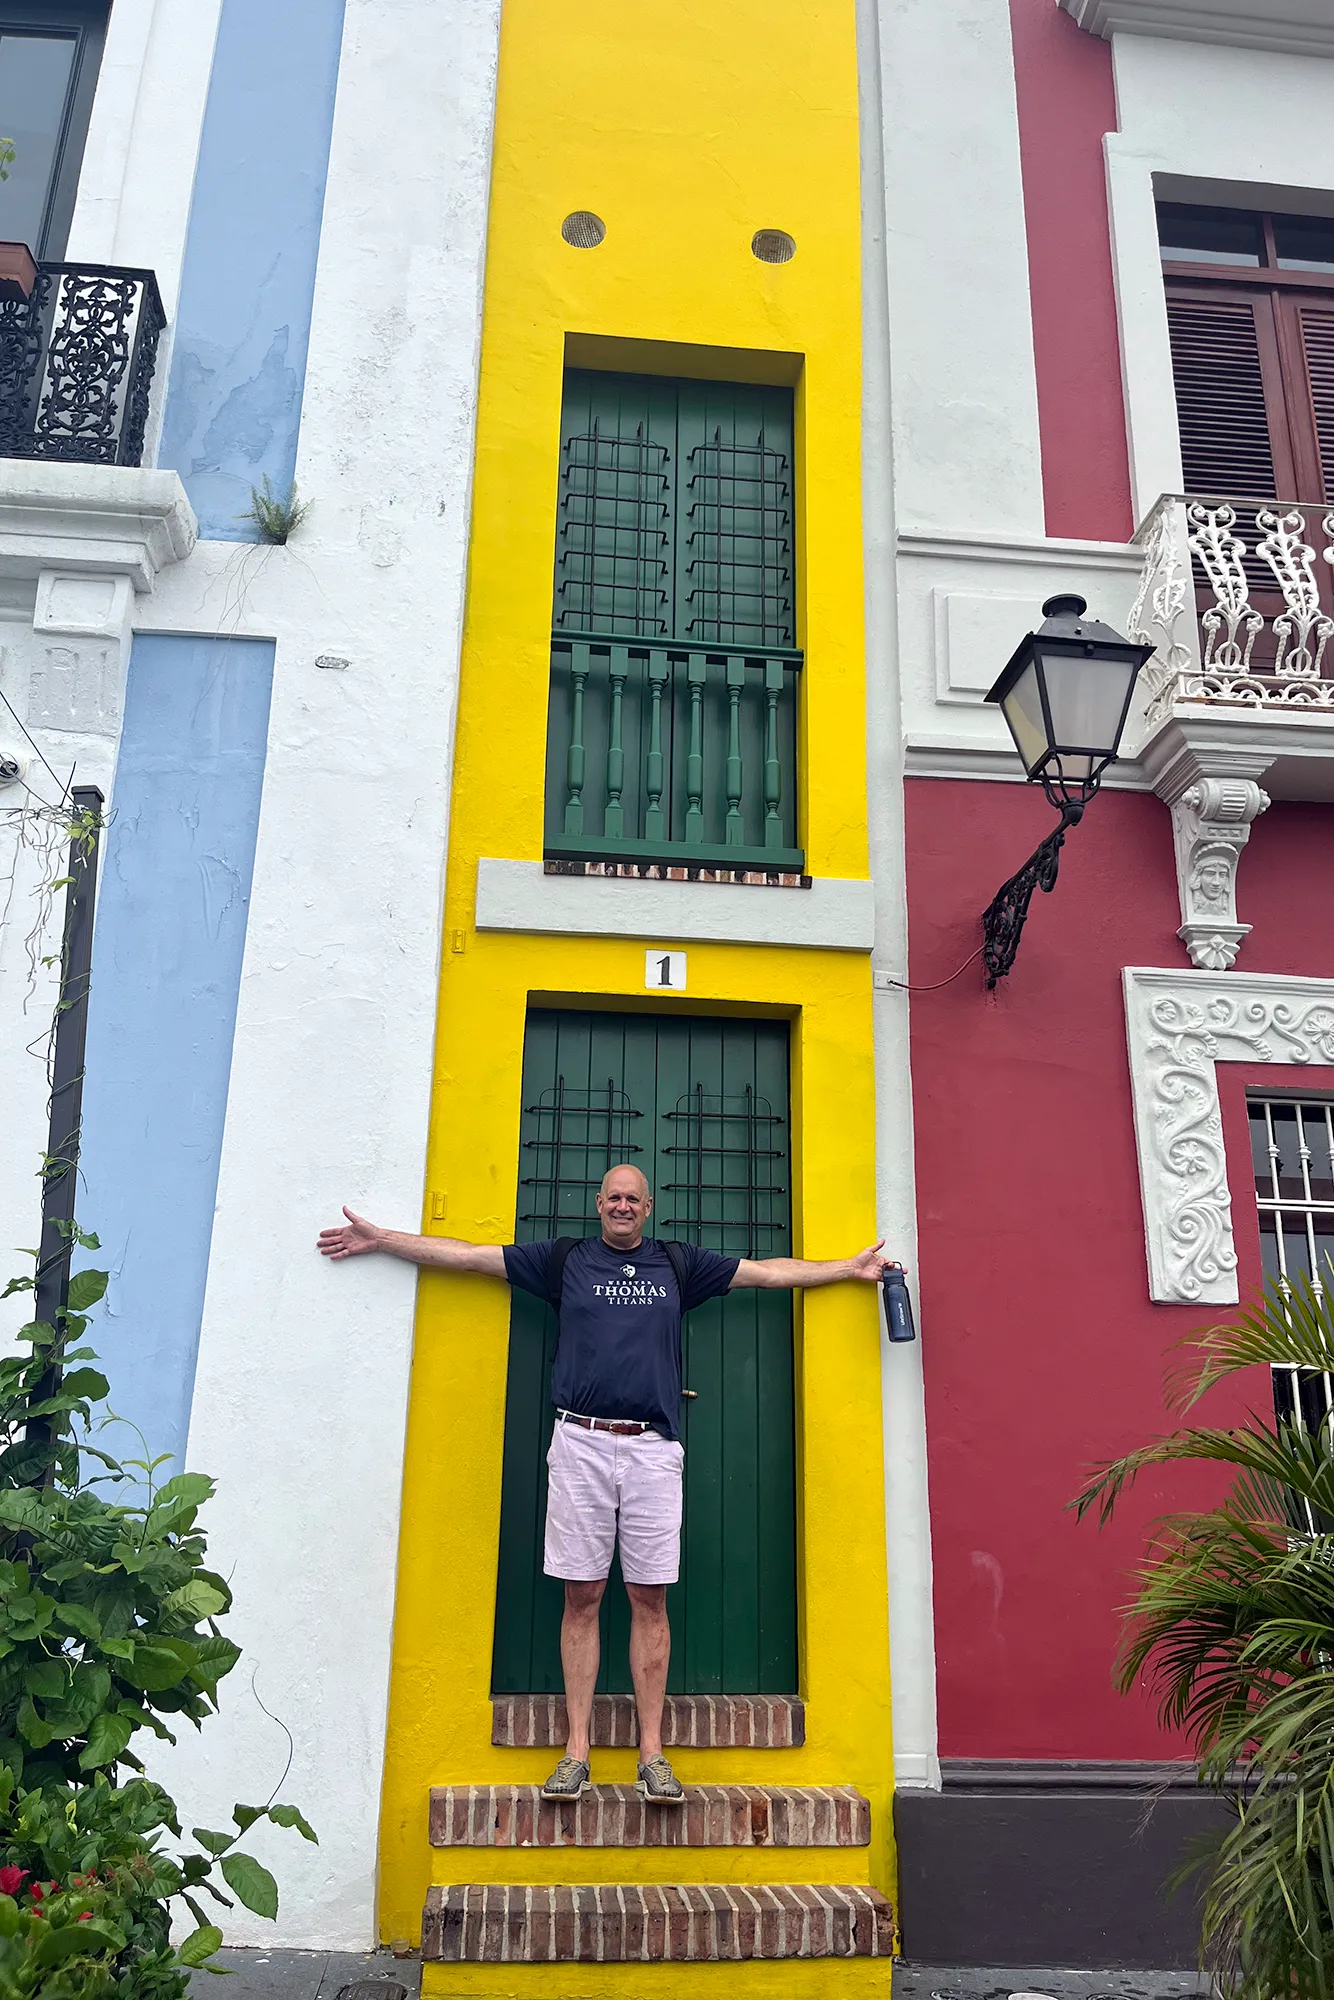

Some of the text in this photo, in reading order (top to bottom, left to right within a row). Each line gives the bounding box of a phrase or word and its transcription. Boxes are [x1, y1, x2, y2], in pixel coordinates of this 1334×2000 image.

[656, 955, 673, 986] 1
[593, 1285, 667, 1297] THOMAS
[608, 1297, 653, 1305] TITANS
